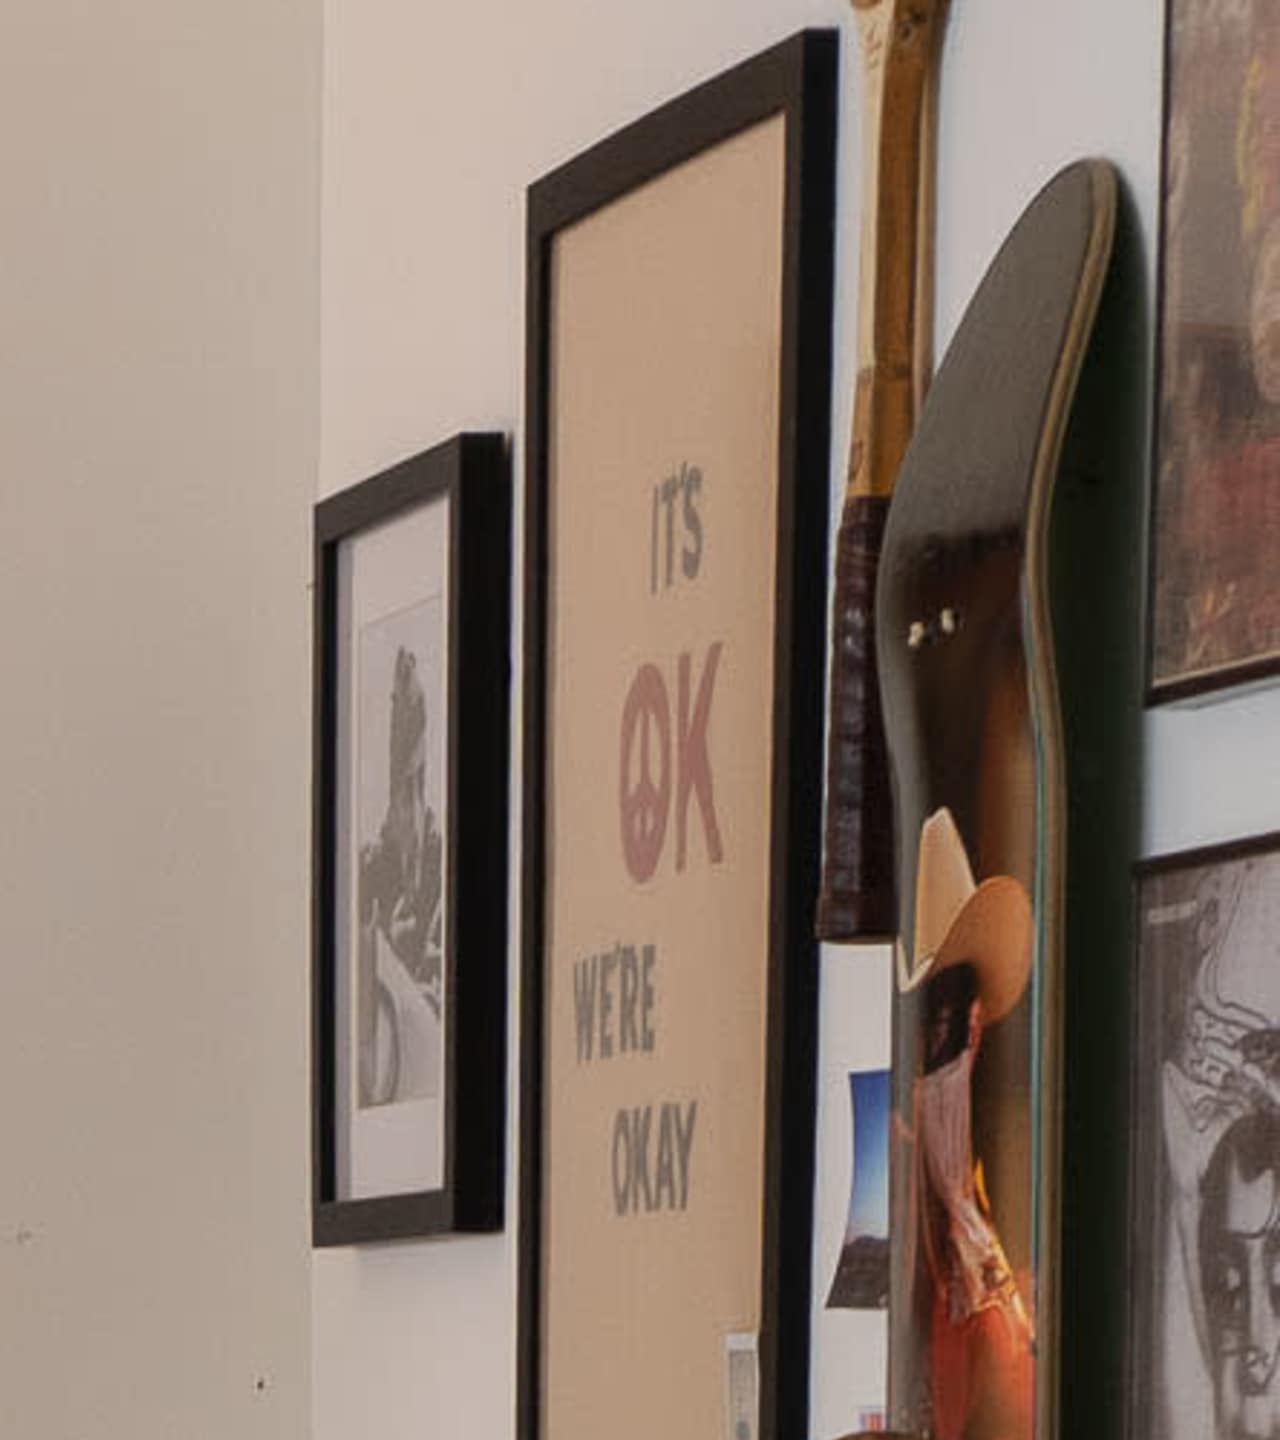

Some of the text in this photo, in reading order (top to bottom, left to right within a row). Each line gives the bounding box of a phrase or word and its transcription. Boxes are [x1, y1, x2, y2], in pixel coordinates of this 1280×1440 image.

[649, 460, 705, 594] IT'S
[618, 642, 725, 884] OK
[572, 940, 657, 1063] WE'RE
[611, 1098, 698, 1219] OKAY
